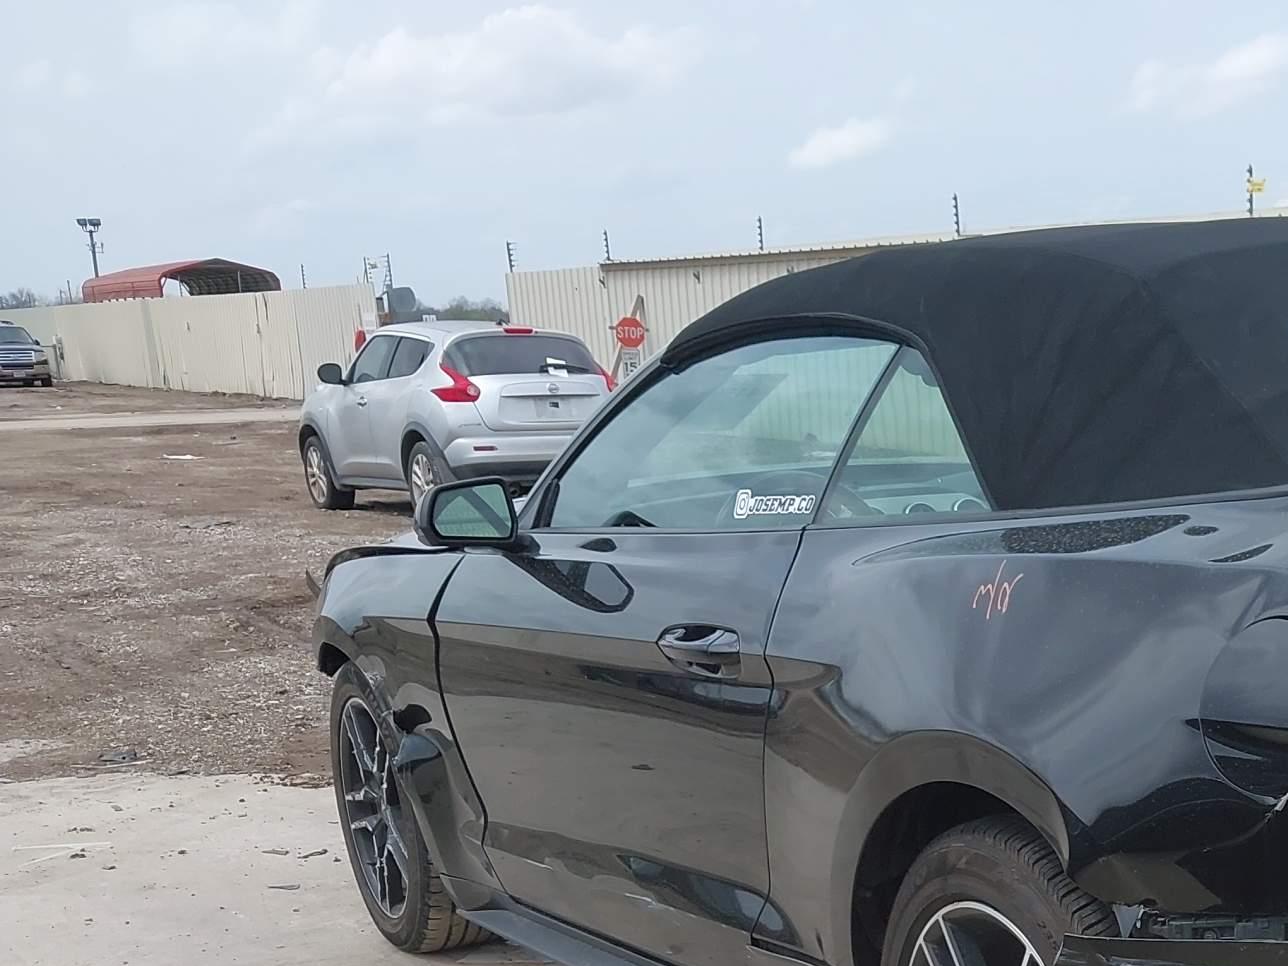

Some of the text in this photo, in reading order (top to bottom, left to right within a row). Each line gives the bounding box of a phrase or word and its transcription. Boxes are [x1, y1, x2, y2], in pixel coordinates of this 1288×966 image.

[617, 326, 644, 339] STOP
[624, 361, 638, 373] 15
[748, 496, 815, 513] JOSEMP.CO
